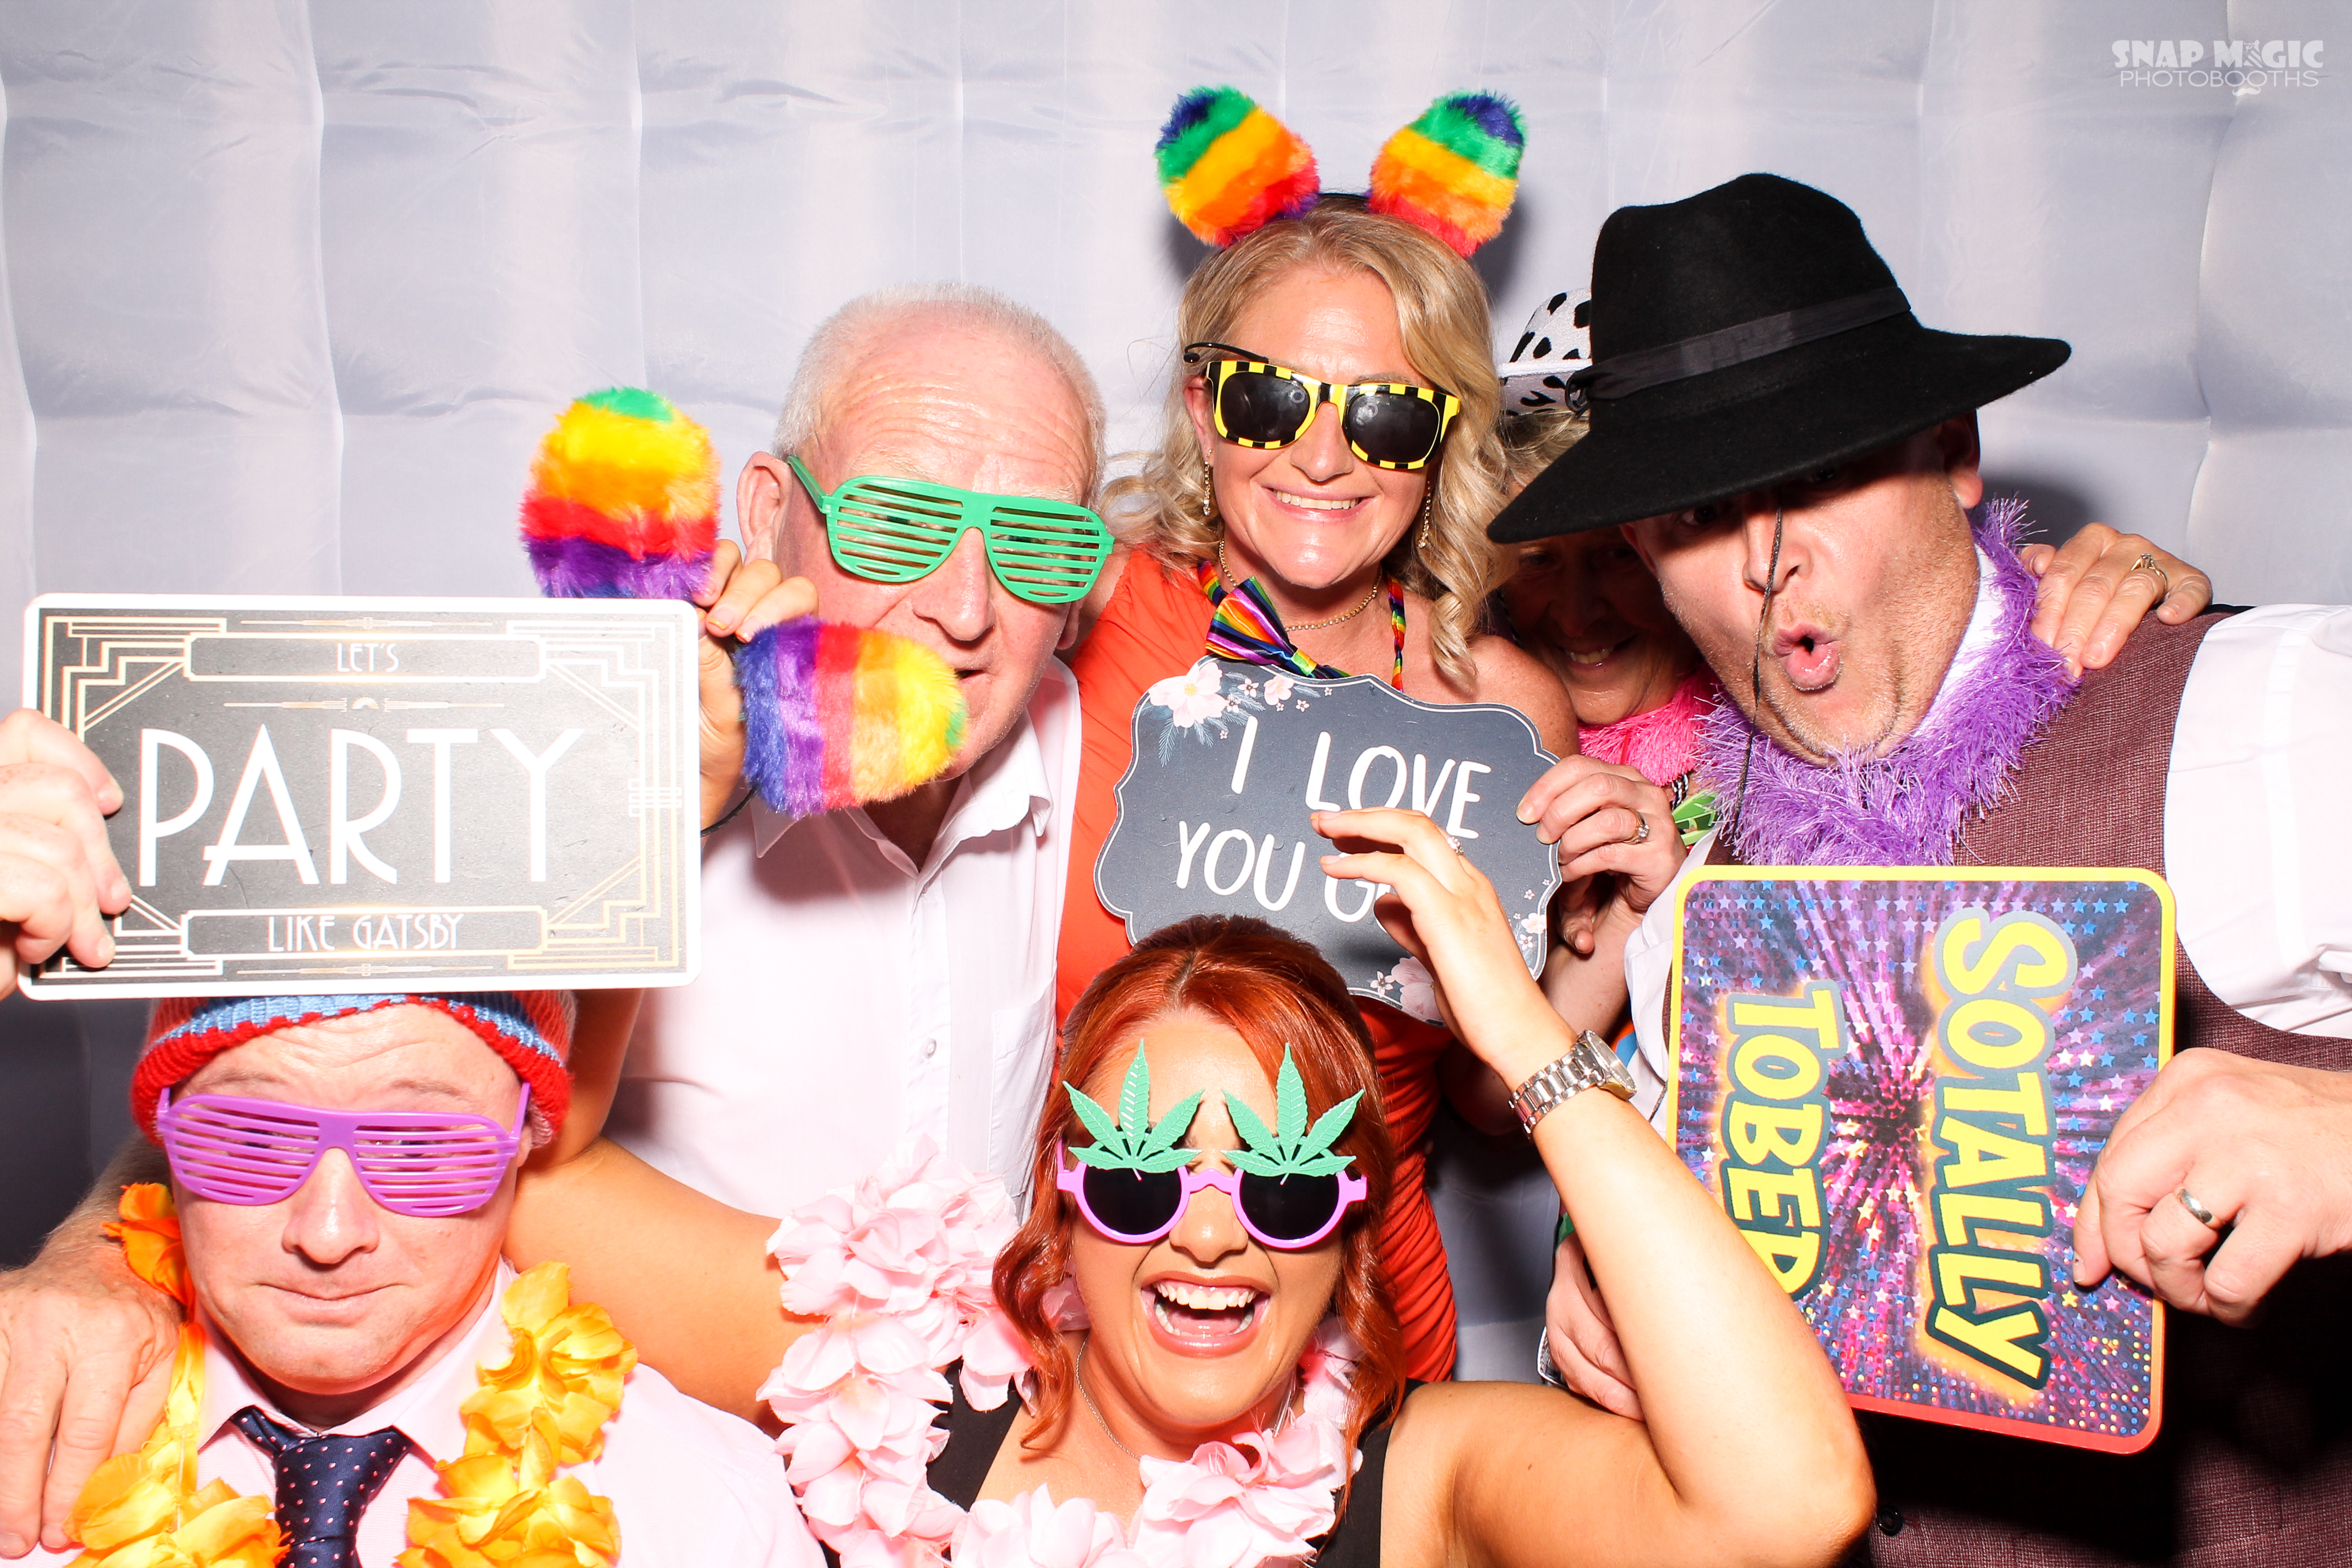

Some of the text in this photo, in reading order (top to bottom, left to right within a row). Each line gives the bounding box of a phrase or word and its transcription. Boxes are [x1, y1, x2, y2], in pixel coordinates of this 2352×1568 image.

[336, 642, 400, 672] LET'S
[138, 723, 586, 886] PARTY
[1231, 715, 1492, 839] I LOVE
[1176, 820, 1306, 911] YOU
[268, 913, 464, 952] LIKE GATSBY
[1930, 913, 2072, 1385] SOTALLY
